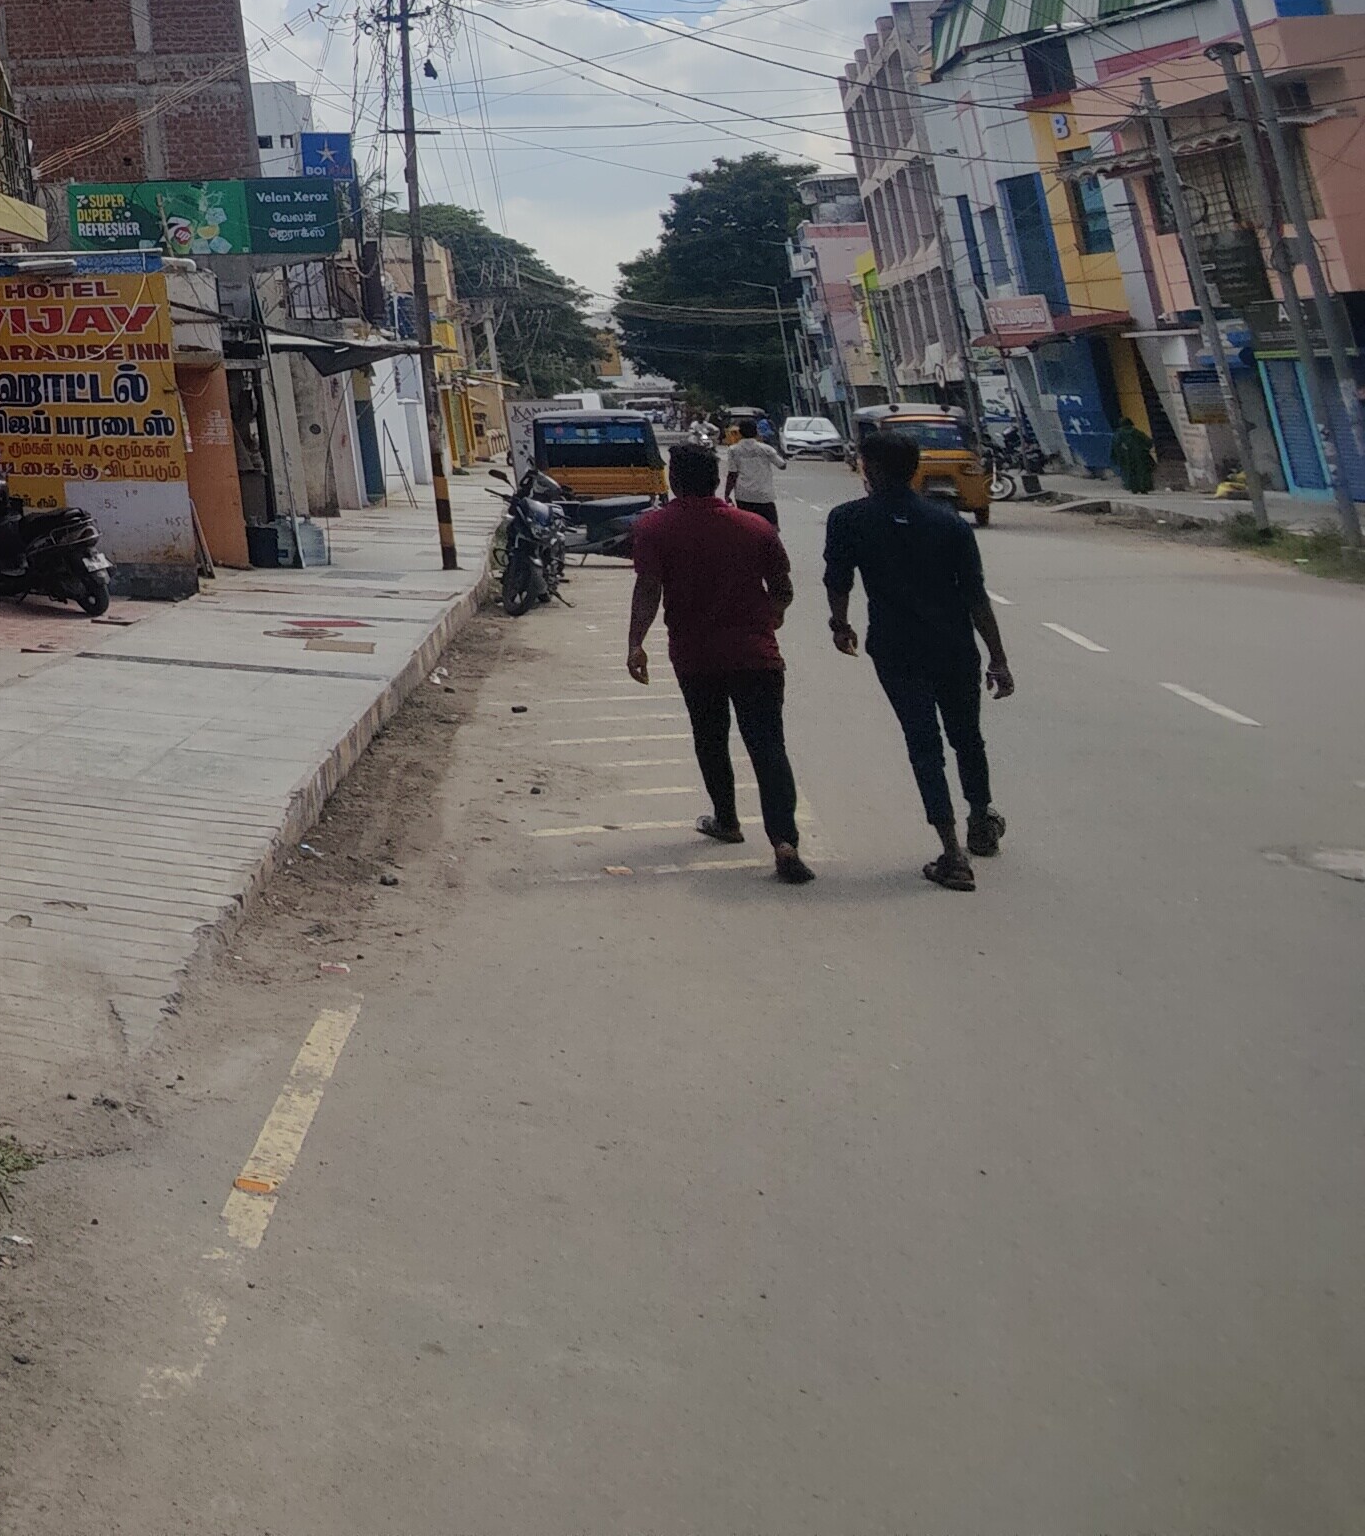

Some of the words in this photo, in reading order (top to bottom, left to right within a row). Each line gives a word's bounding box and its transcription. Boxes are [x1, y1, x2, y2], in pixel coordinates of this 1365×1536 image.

[305, 166, 327, 176] BOI
[89, 194, 125, 208] SUPER
[256, 192, 291, 203] Velan
[293, 192, 329, 203] Xerox
[77, 208, 113, 222] DUPER
[77, 221, 141, 237] REFRESHER
[4, 280, 120, 299] HOTEL
[128, 343, 170, 360] INN
[55, 409, 176, 440] பாரடைஸ்
[8, 437, 53, 457] ரூம்கள்
[57, 442, 84, 456] NON
